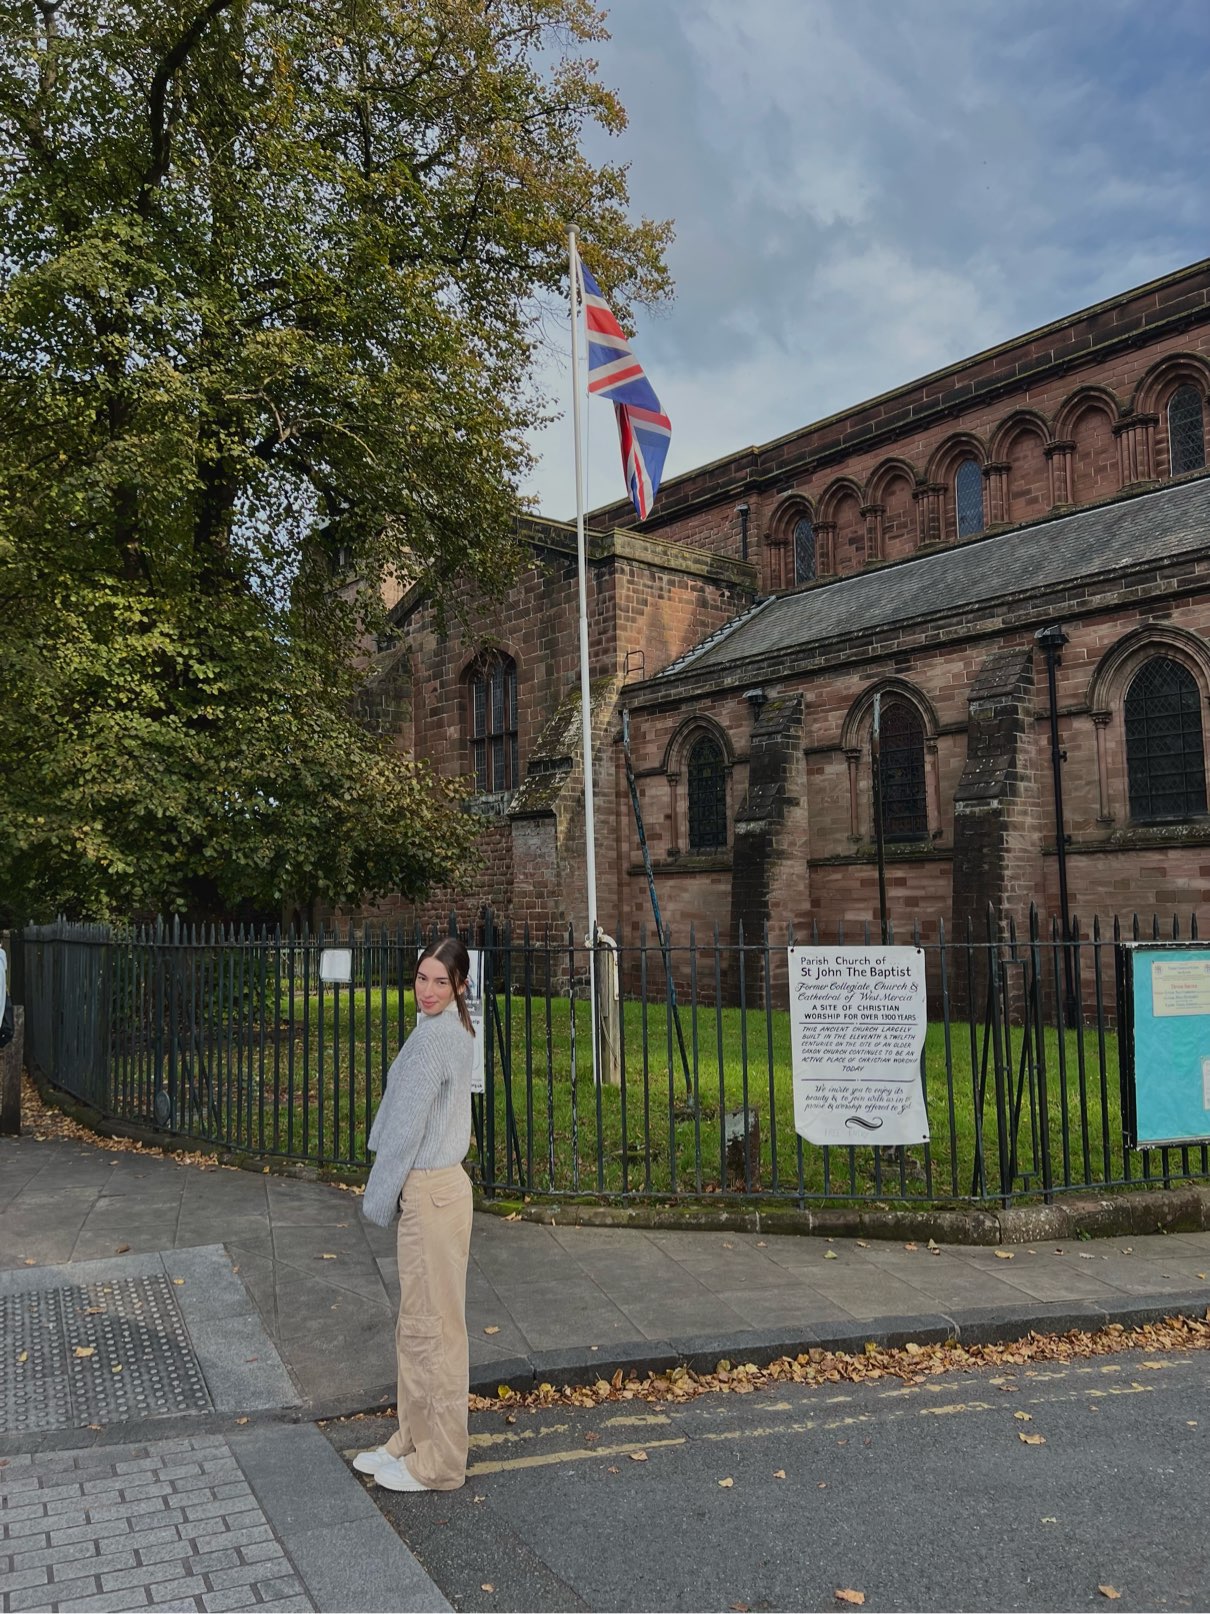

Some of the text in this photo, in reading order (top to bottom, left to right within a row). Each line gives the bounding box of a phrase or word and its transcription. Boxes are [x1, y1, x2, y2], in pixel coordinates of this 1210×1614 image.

[801, 956, 887, 965] Parish Church of
[801, 967, 911, 980] St John The Baptist
[795, 982, 828, 992] Former
[874, 981, 908, 991] Church
[798, 991, 913, 1003] Cathedral of West Mercia
